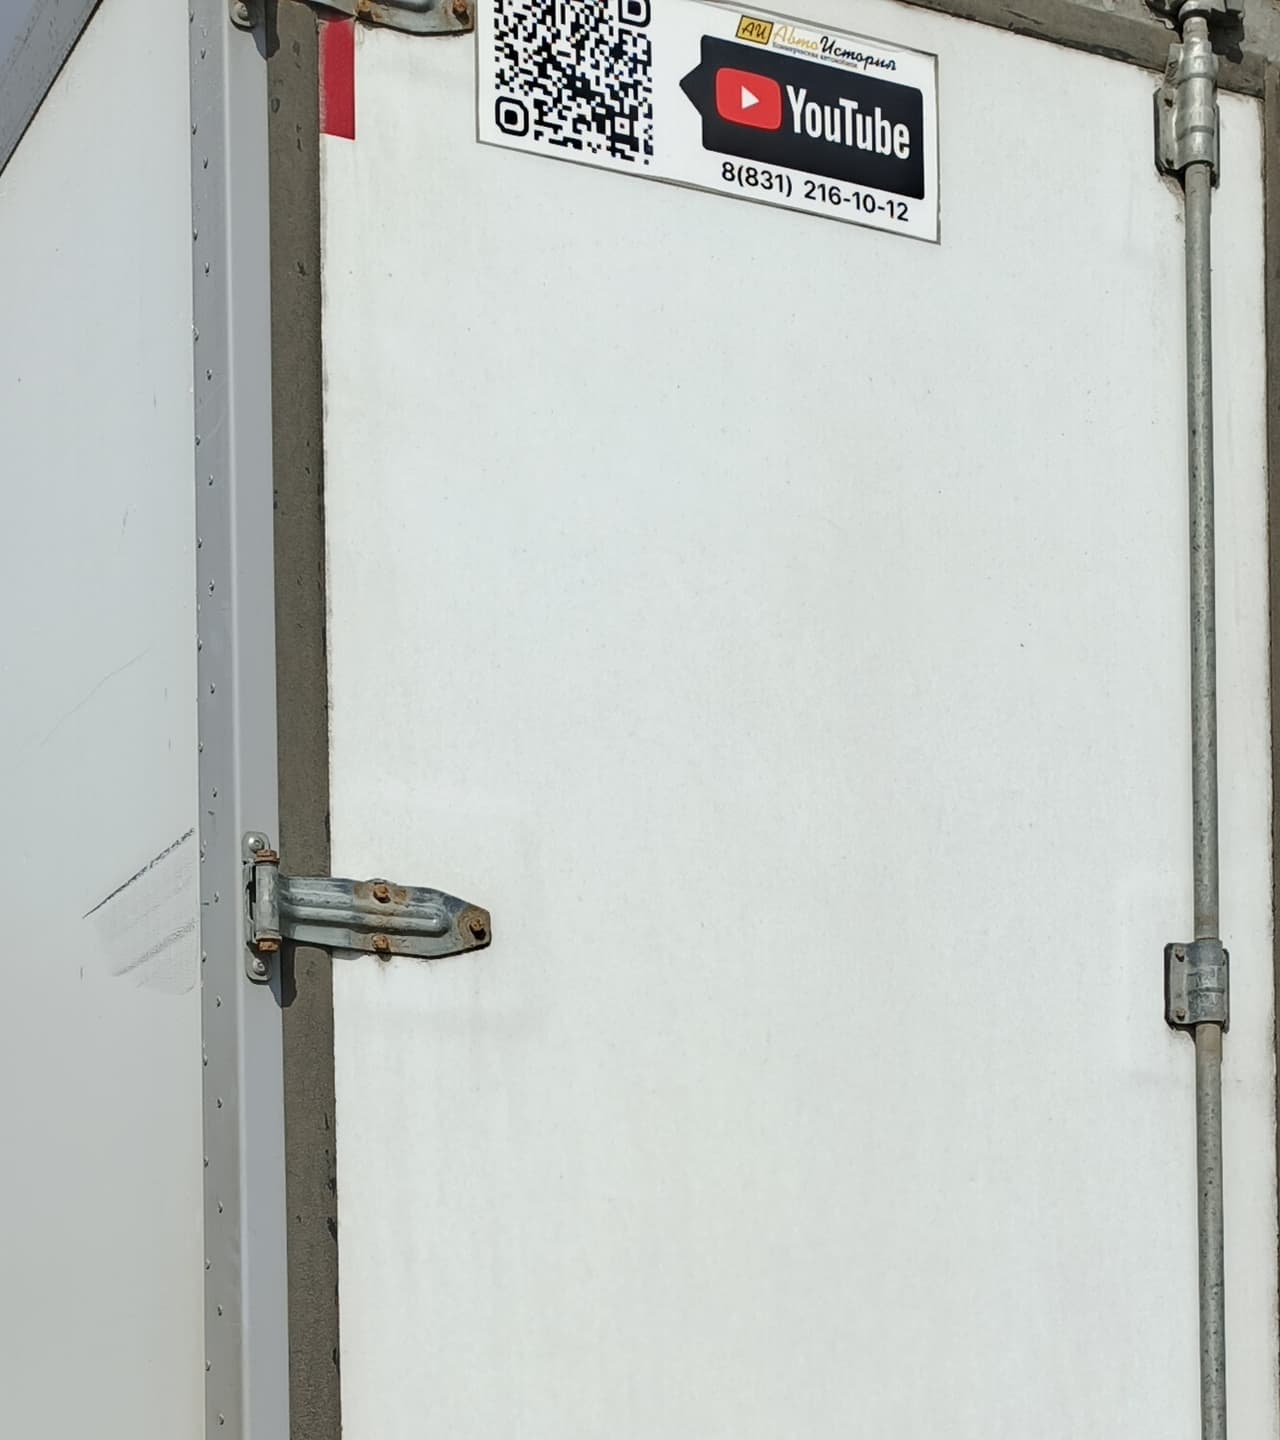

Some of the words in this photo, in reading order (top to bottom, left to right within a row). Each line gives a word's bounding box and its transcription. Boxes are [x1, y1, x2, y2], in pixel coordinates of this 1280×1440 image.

[786, 85, 910, 160] YouTube
[721, 162, 793, 198] 8(831)
[804, 180, 909, 222] 216-10-12
